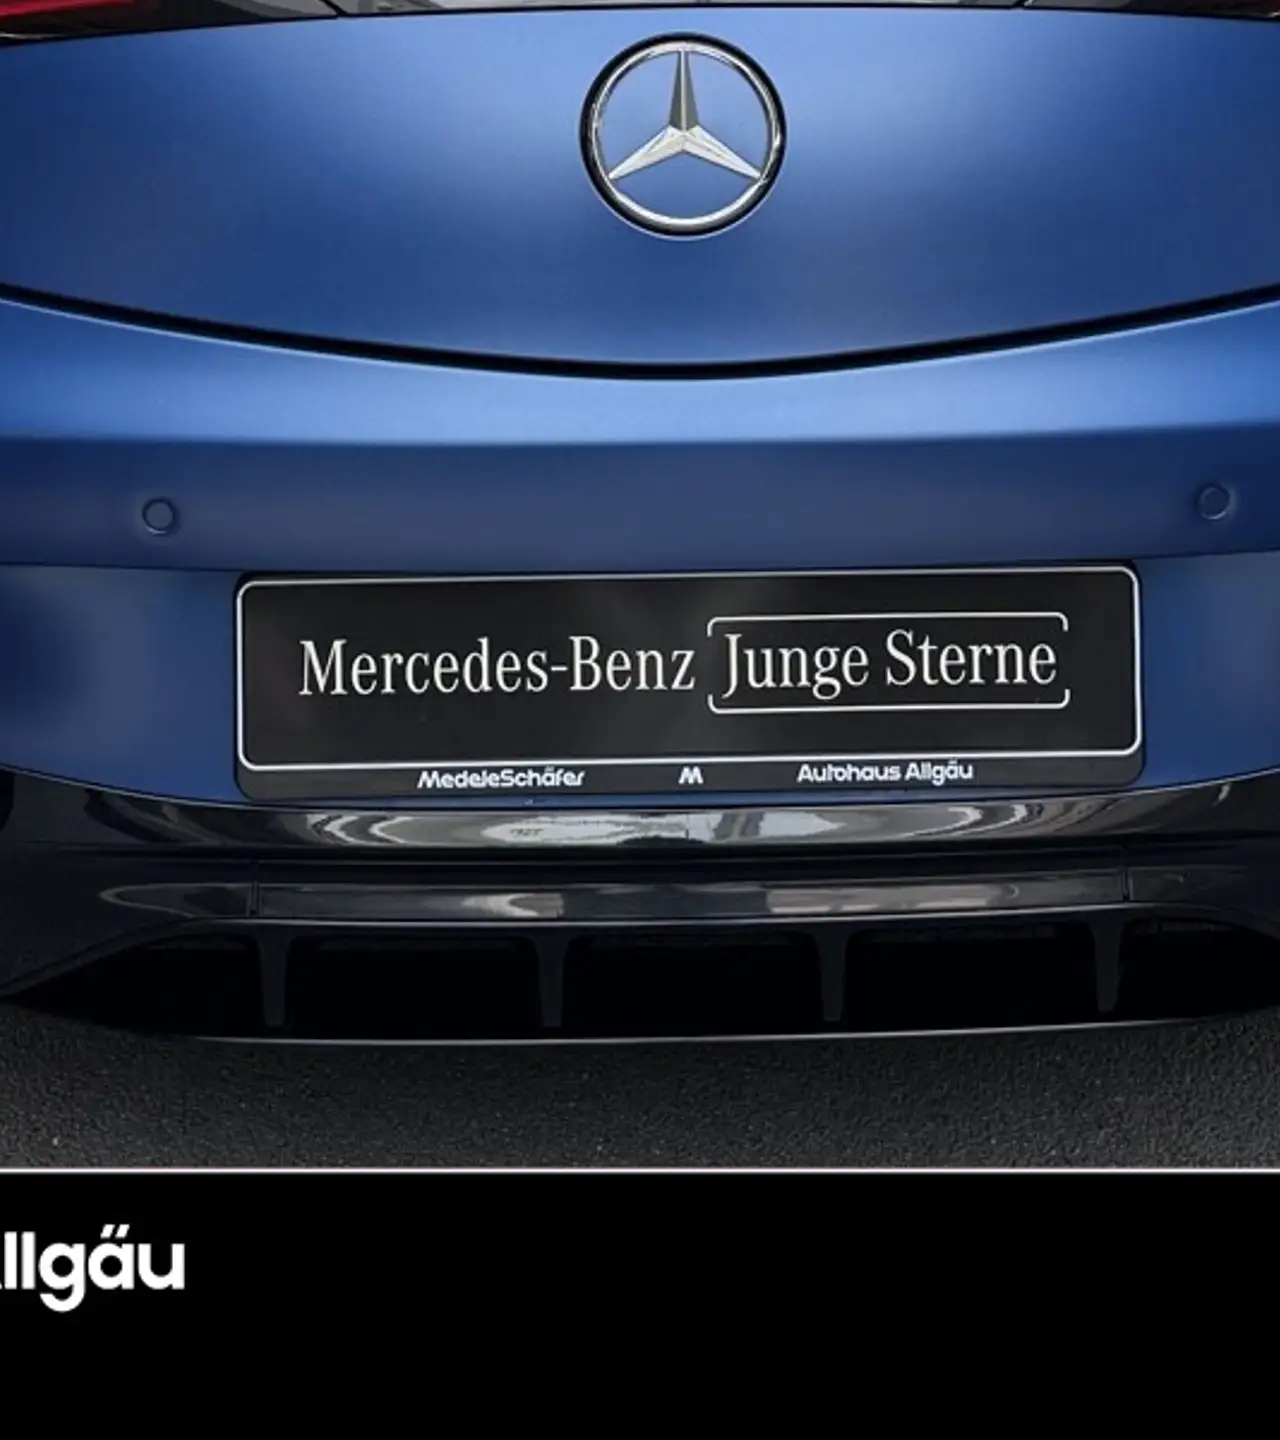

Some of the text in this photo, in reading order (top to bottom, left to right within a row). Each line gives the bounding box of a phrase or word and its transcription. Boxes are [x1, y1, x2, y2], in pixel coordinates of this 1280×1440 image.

[298, 628, 1058, 700] Mercedes-Benz Junge Sterne
[417, 766, 586, 790] MedeleSchäfer
[796, 758, 974, 787] Autohaus Allgäu
